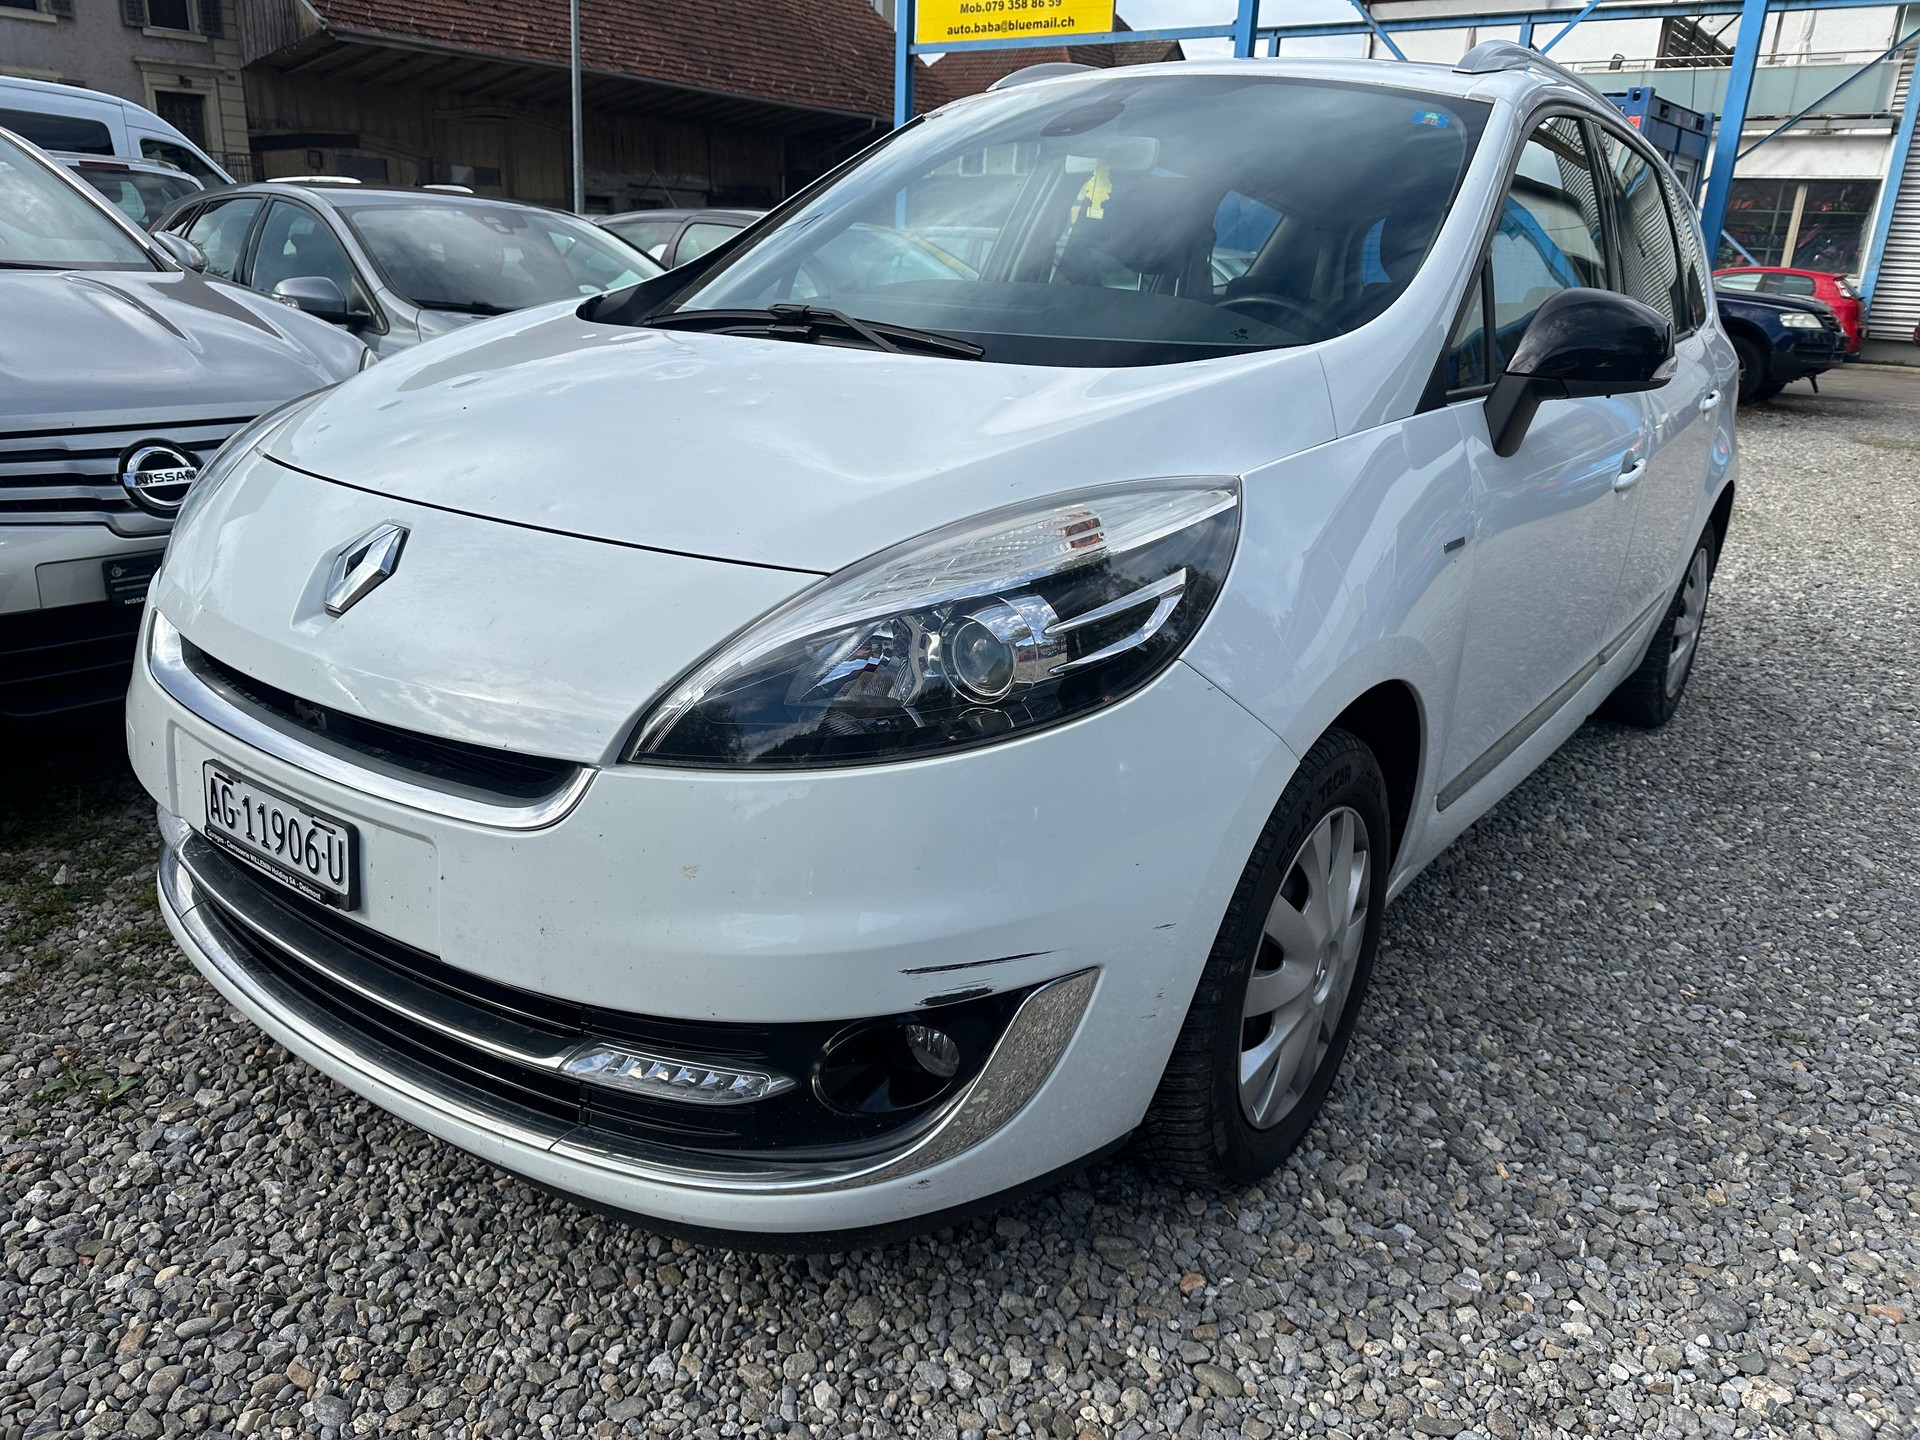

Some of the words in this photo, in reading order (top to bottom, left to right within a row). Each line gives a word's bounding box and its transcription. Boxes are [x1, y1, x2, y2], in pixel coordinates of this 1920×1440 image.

[960, 1, 1004, 13] Mob.079
[1008, 0, 1028, 10] 358
[1031, 0, 1045, 8] 86
[947, 16, 1075, 35] auto.baba@bluemail.ch
[134, 470, 197, 485] NISSAN
[124, 596, 147, 605] NISSA
